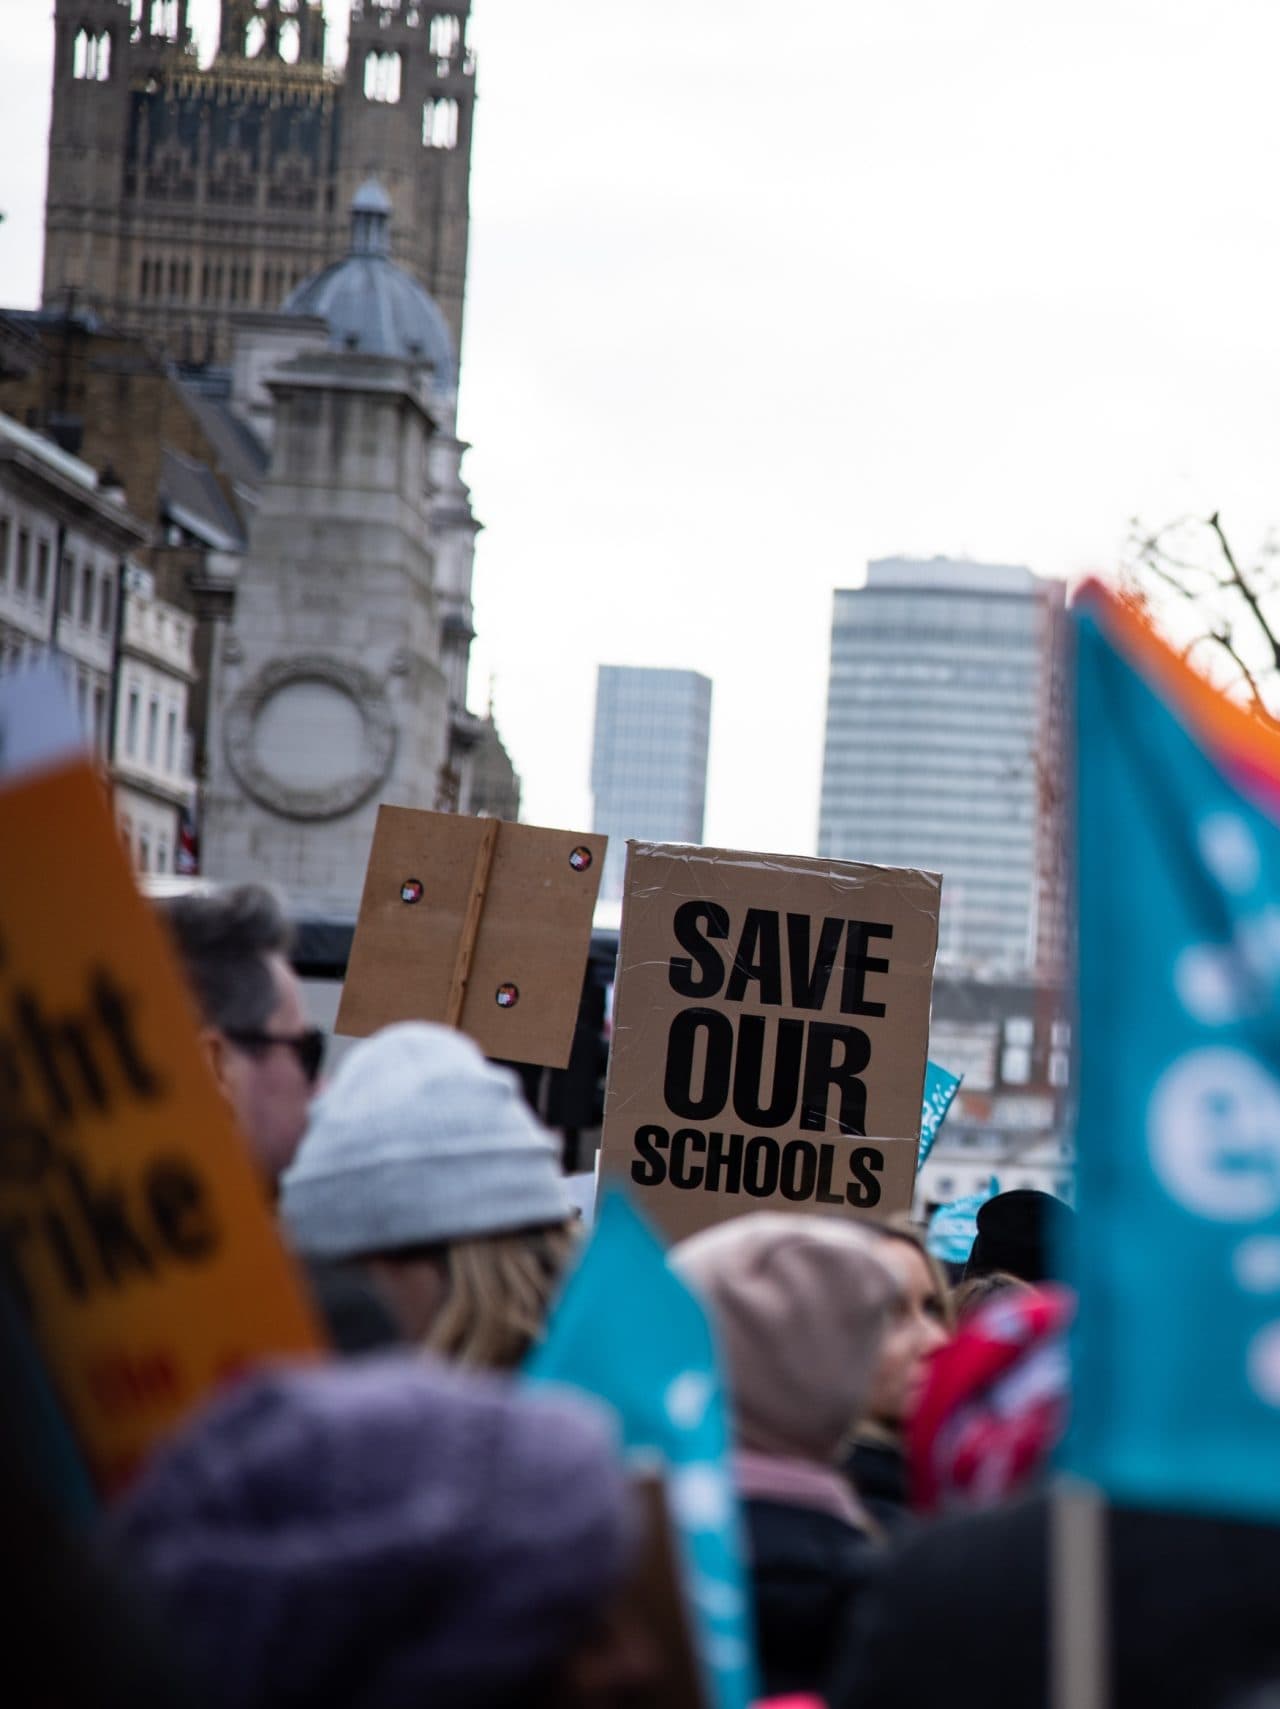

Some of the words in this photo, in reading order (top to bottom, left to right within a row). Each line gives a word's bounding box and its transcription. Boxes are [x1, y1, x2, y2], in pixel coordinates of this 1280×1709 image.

[668, 900, 894, 1018] SAVE
[663, 1006, 872, 1137] OUR
[630, 1124, 885, 1209] SCHOOLS
